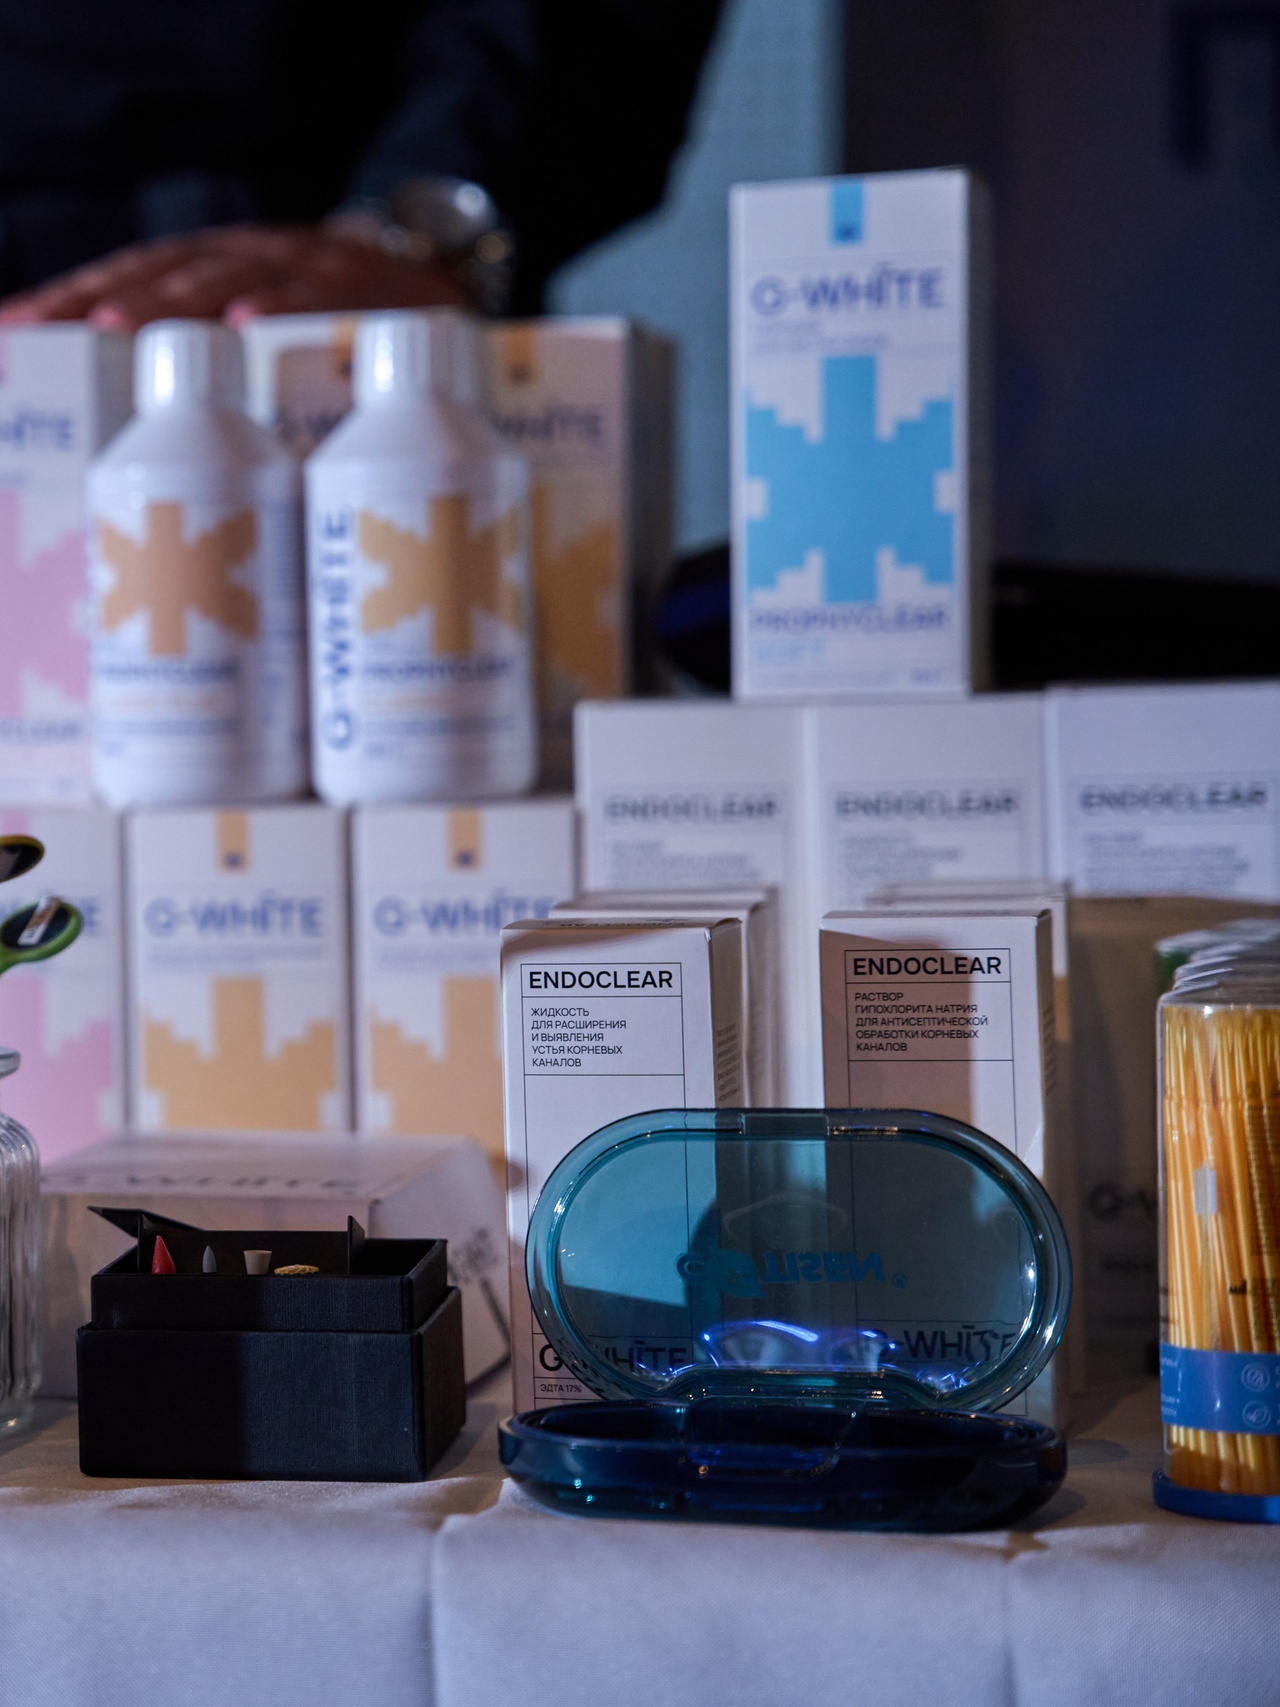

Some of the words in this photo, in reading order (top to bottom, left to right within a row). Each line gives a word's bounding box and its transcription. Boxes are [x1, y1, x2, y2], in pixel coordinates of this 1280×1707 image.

[853, 956, 1002, 976] ENDOCLEAR
[529, 970, 674, 989] ENDOCLEAR
[854, 992, 904, 1001] РАСТВОР
[531, 1007, 590, 1018] ЖИДКОСТЬ
[854, 1004, 934, 1014] ГИПОХЛОРИТА
[935, 1004, 978, 1013] НАТРИЯ
[531, 1020, 553, 1030] ДЛЯ
[555, 1020, 627, 1030] РАСШИРЕНИЯ
[855, 1017, 879, 1027] ДЛЯ
[880, 1015, 989, 1027] АНТИСЕПТИЧЕСКОЙ
[531, 1033, 539, 1042] И
[541, 1033, 604, 1042] ВЫЯВЛЕНИЯ
[855, 1029, 919, 1039] ОБРАБОТКИ
[921, 1029, 980, 1039] КОРНЕВЫХ
[532, 1045, 565, 1055] УСТЬЯ
[567, 1045, 623, 1055] КОРНЕВЫХ
[856, 1042, 908, 1052] КАНАЛОВ
[532, 1058, 582, 1068] КАНАЛОВ
[540, 1384, 564, 1393] ЭДТА
[566, 1384, 582, 1393] 17%
